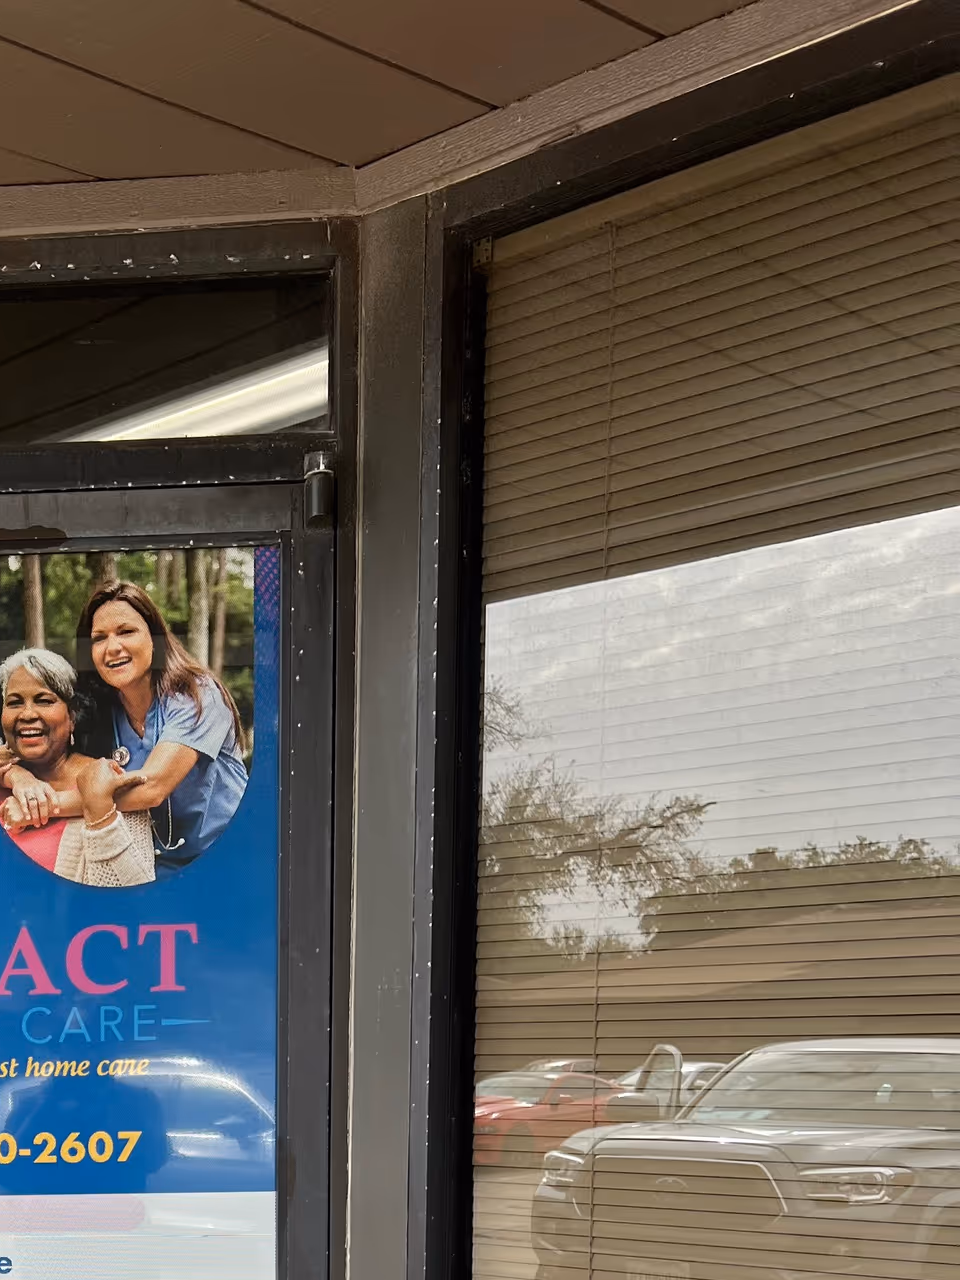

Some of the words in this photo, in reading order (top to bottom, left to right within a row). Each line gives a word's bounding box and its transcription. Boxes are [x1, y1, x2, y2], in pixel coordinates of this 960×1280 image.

[20, 1004, 158, 1043] CARE
[25, 1057, 90, 1077] home
[97, 1059, 149, 1076] care
